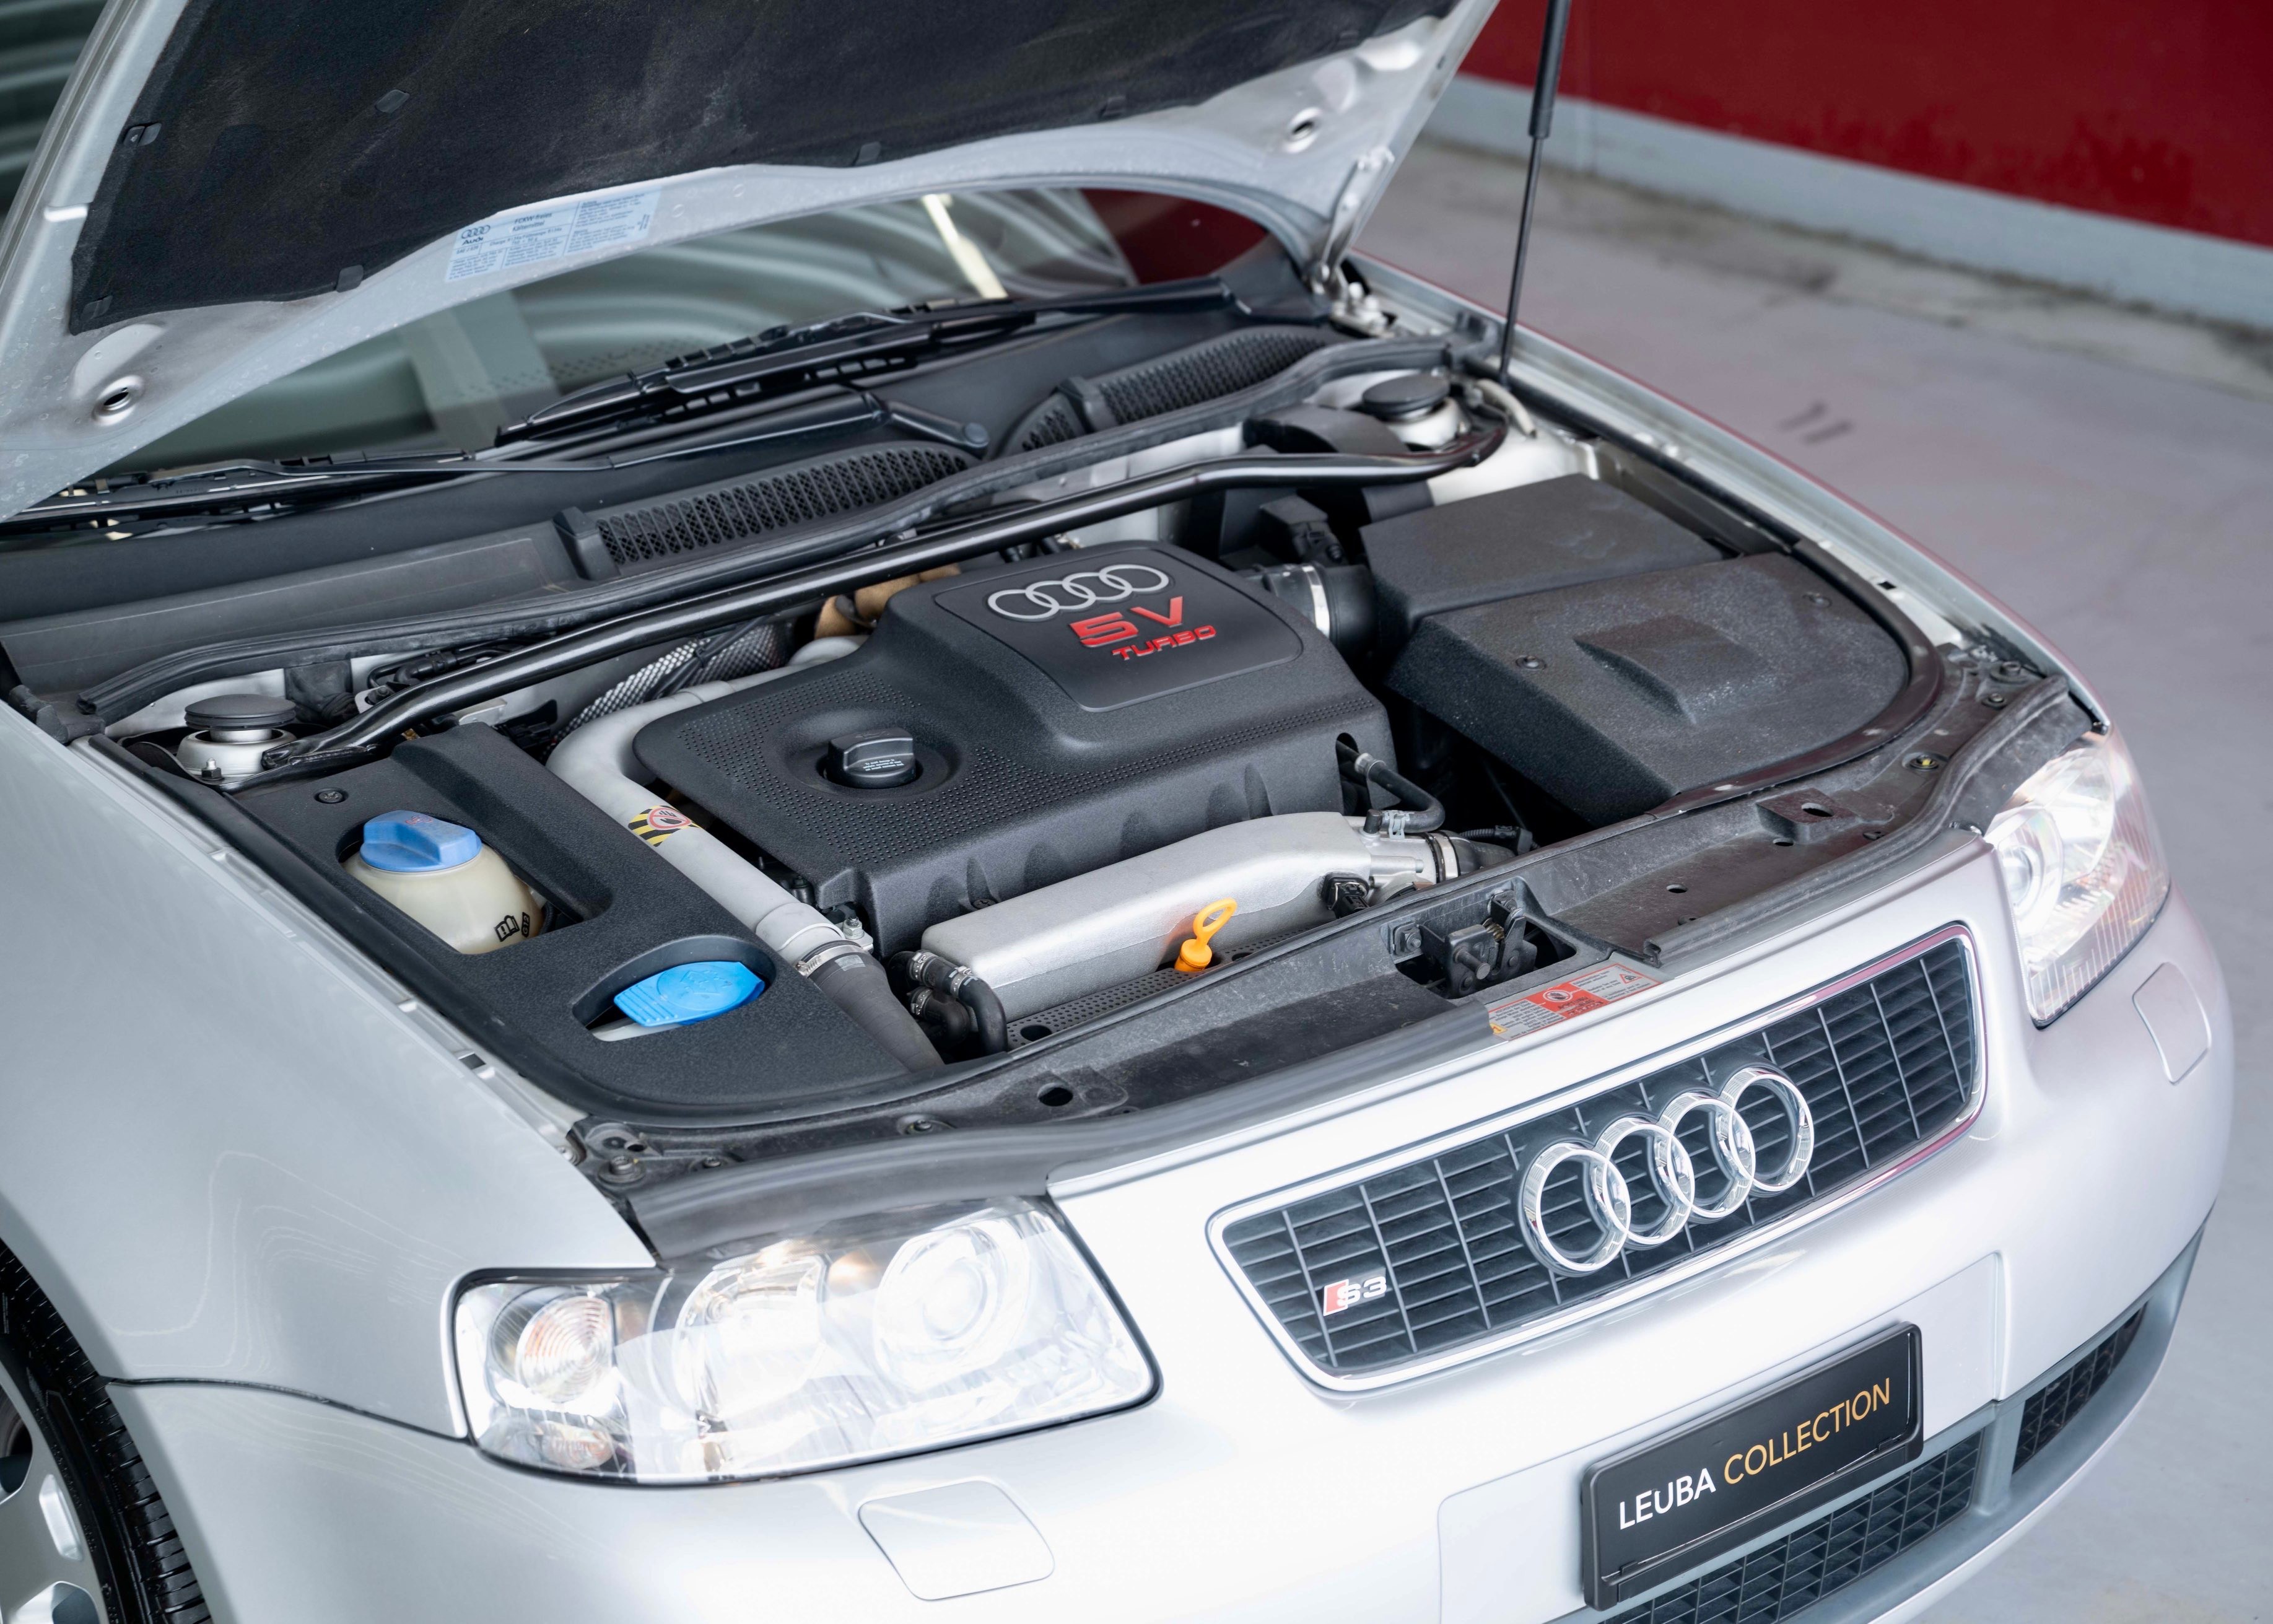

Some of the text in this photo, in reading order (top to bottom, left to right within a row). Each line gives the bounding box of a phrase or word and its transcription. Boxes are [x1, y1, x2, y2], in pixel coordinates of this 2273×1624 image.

[462, 237, 484, 245] Audi
[1069, 595, 1184, 647] 5V
[1112, 624, 1217, 661] TURBO
[1336, 1275, 1387, 1307] S3
[1619, 1377, 1891, 1530] LEUBA COLLECTION
